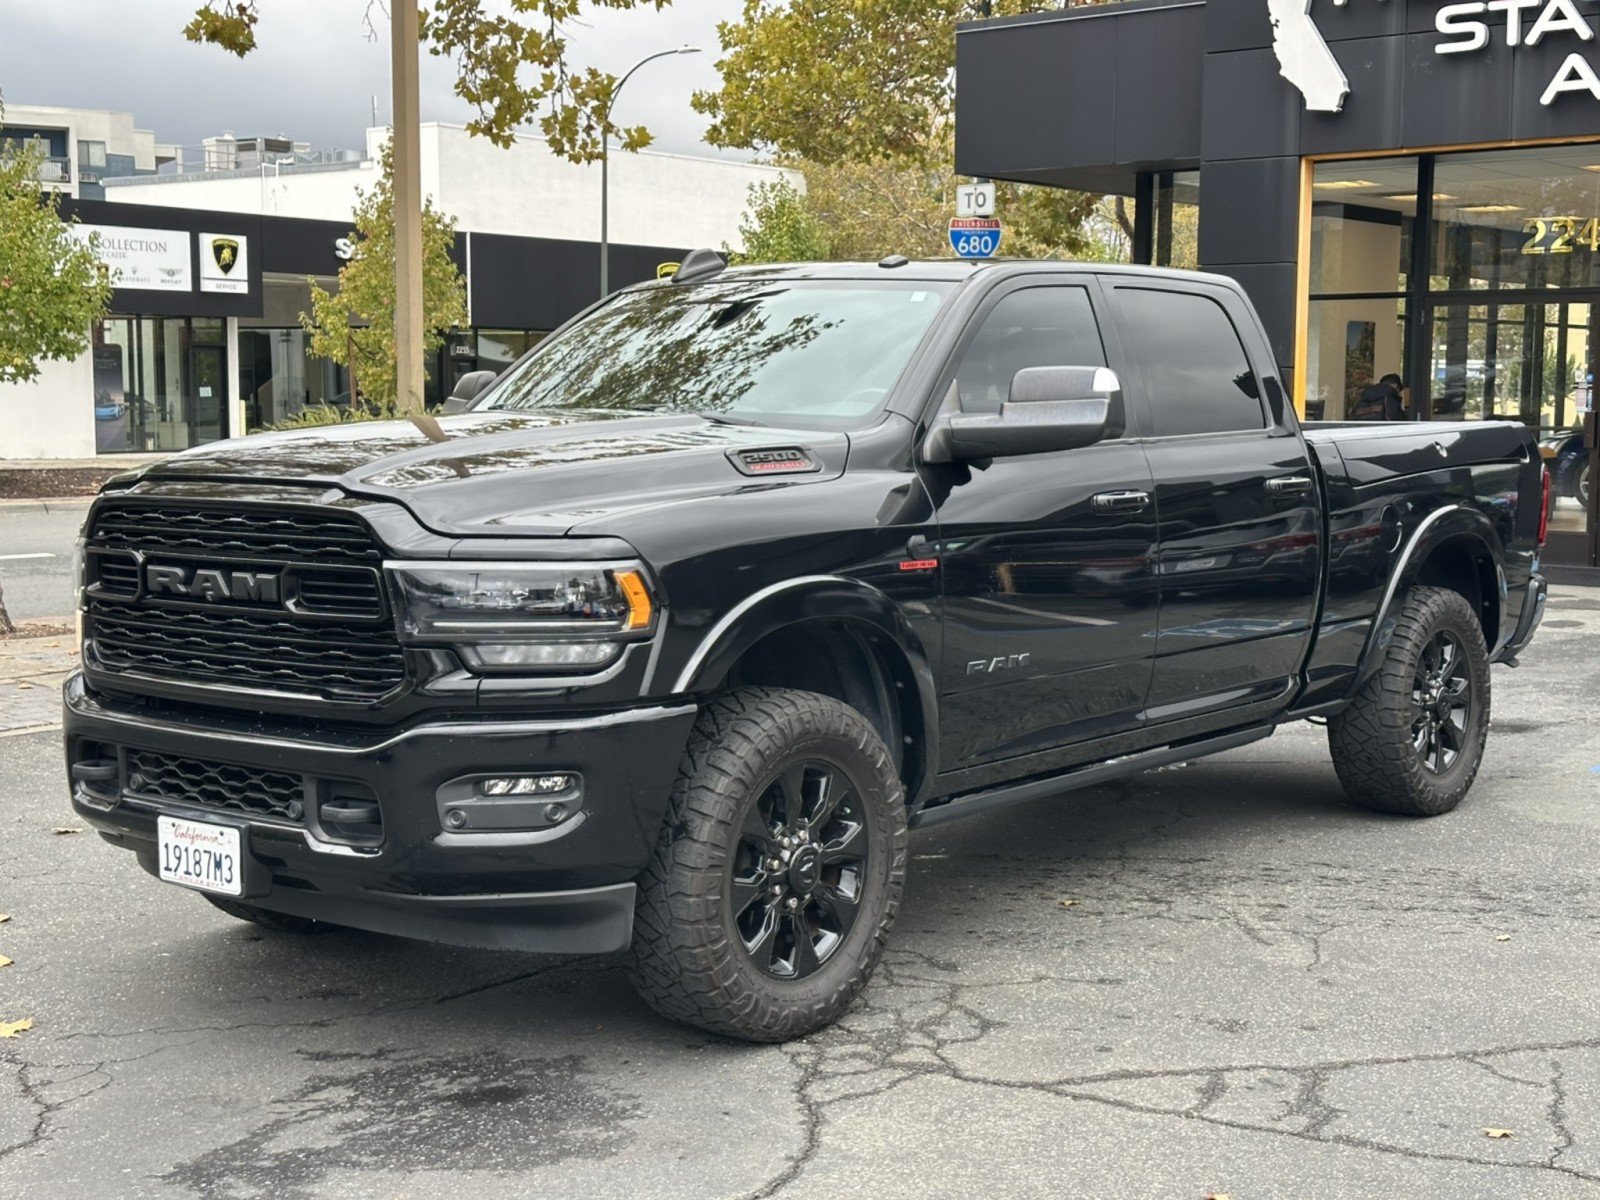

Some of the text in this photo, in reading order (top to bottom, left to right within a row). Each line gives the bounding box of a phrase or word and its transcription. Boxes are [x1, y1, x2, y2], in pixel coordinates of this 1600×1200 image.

[964, 192, 987, 208] TO
[97, 237, 168, 253] OLLECTION
[958, 236, 992, 253] 680
[742, 449, 803, 464] 2500
[146, 564, 279, 602] RAM
[966, 652, 1031, 676] RAM
[174, 823, 225, 846] California
[163, 842, 234, 884] 19187M3
